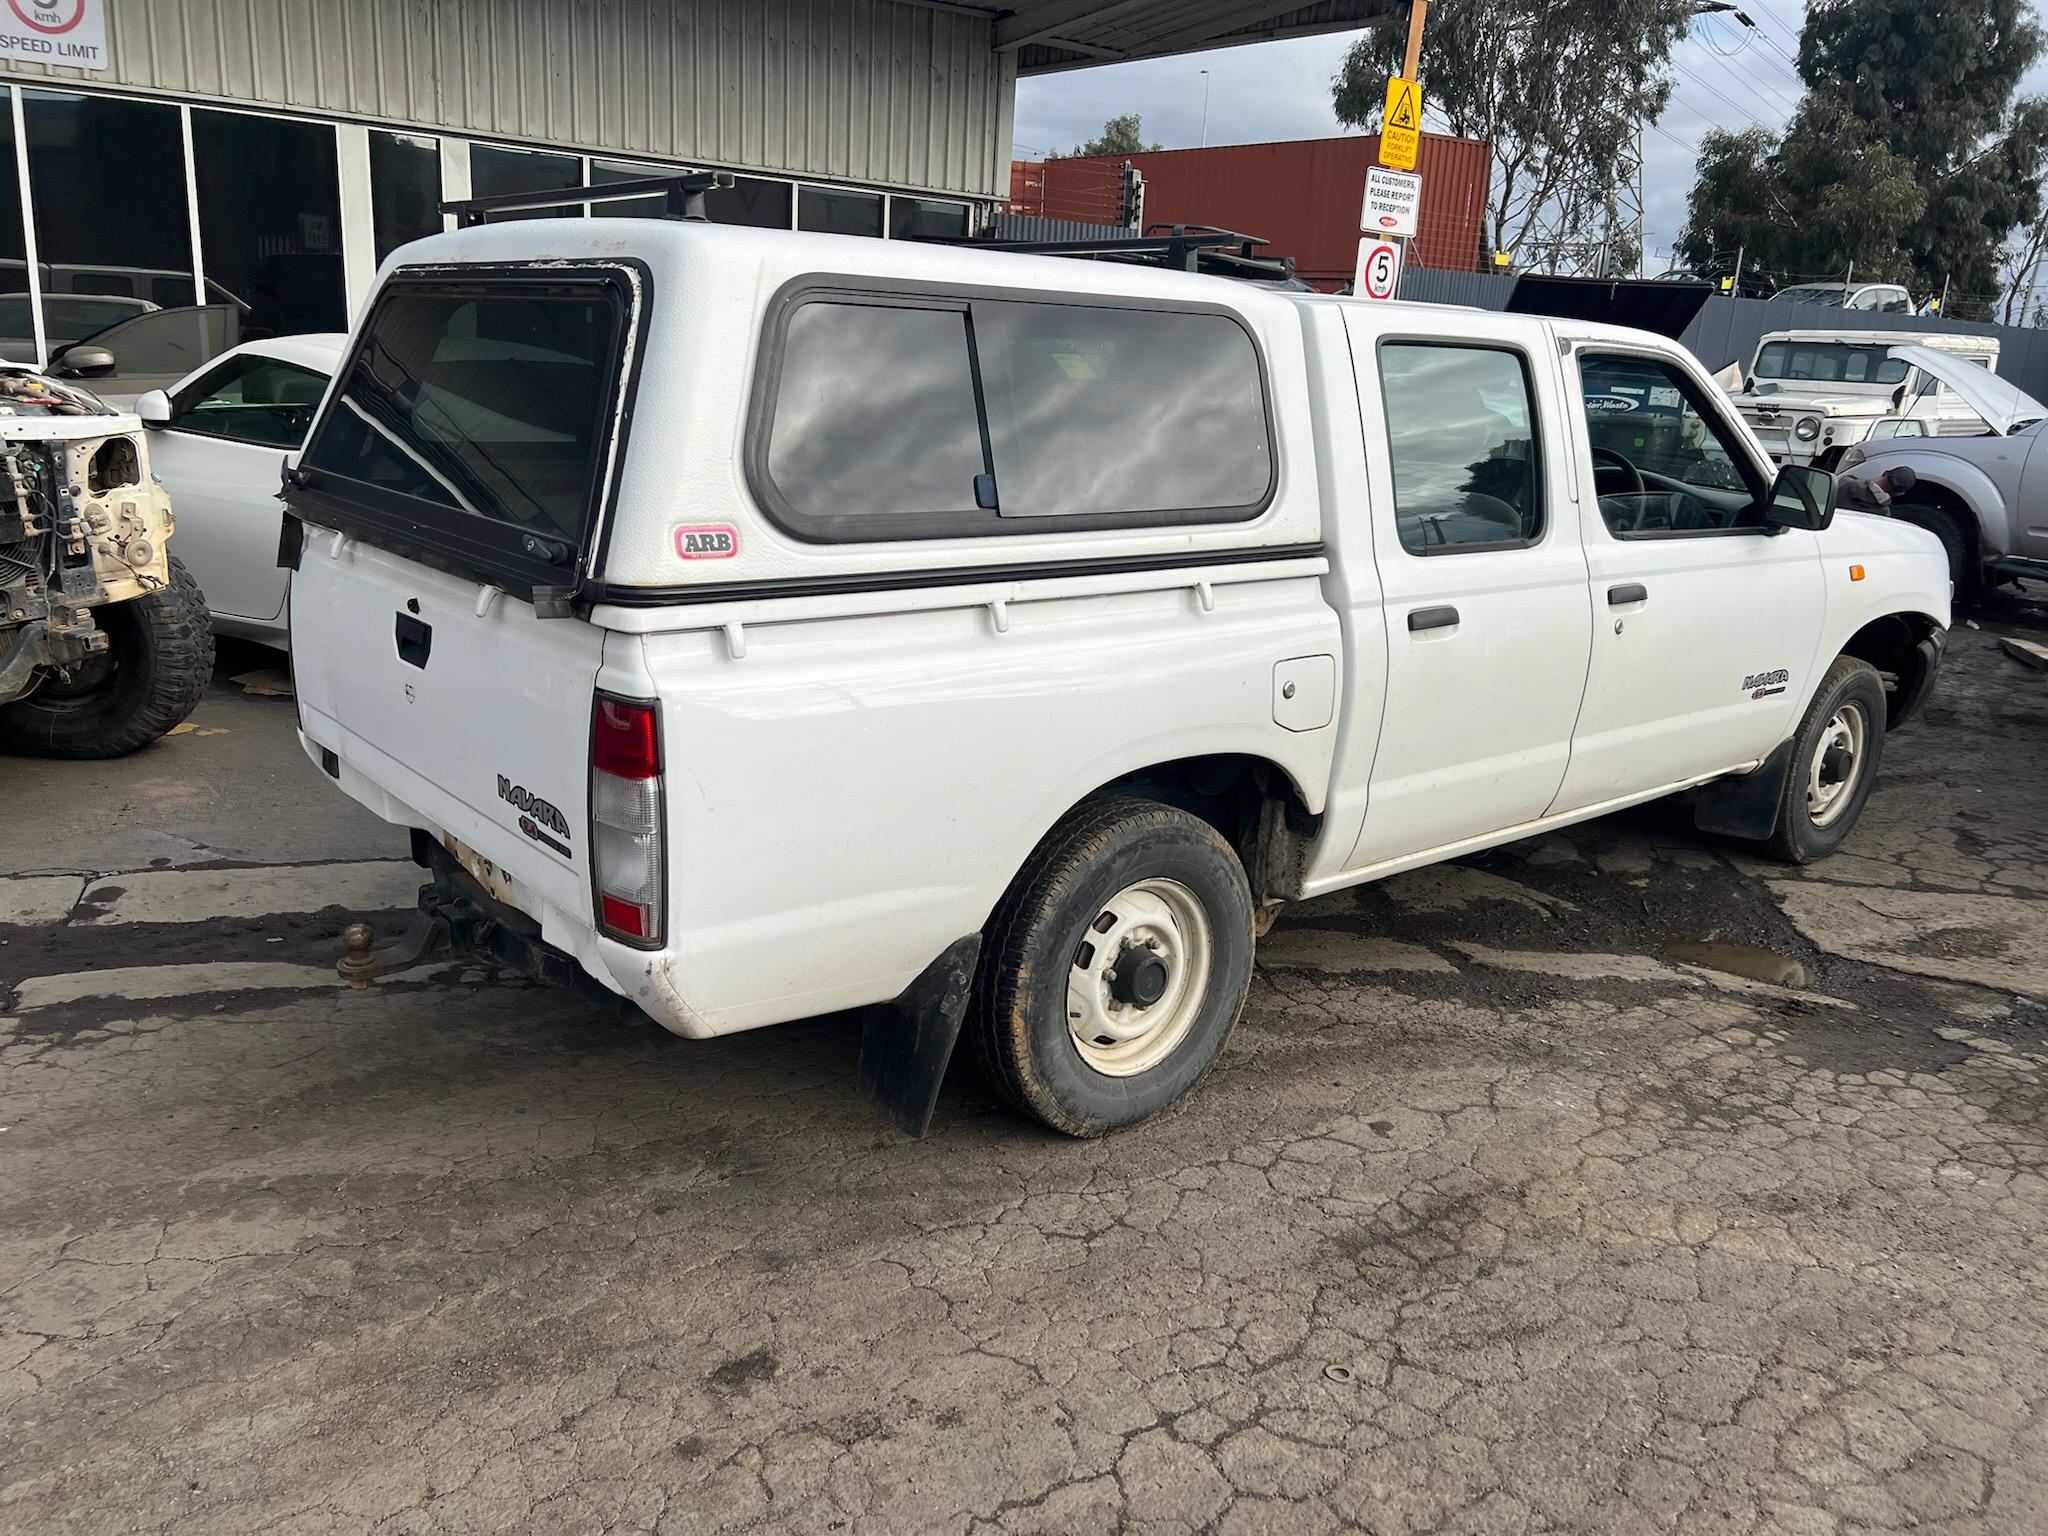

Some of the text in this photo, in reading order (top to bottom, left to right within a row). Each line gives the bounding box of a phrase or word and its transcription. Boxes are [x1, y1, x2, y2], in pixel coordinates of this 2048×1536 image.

[34, 9, 62, 23] kmh
[0, 34, 99, 60] SPEED LIMIT
[1386, 130, 1415, 145] CAUTION
[1386, 142, 1413, 154] FORKLIFT
[1383, 150, 1414, 165] OPERATING
[1370, 174, 1381, 184] ALL
[1369, 187, 1415, 203] PLEASE REPORT
[1370, 200, 1411, 215] TO RECEPTION
[1376, 254, 1390, 283] 5
[684, 533, 732, 553] ARB
[1741, 668, 1790, 691] NAVARA
[497, 773, 571, 840] NAVARA
